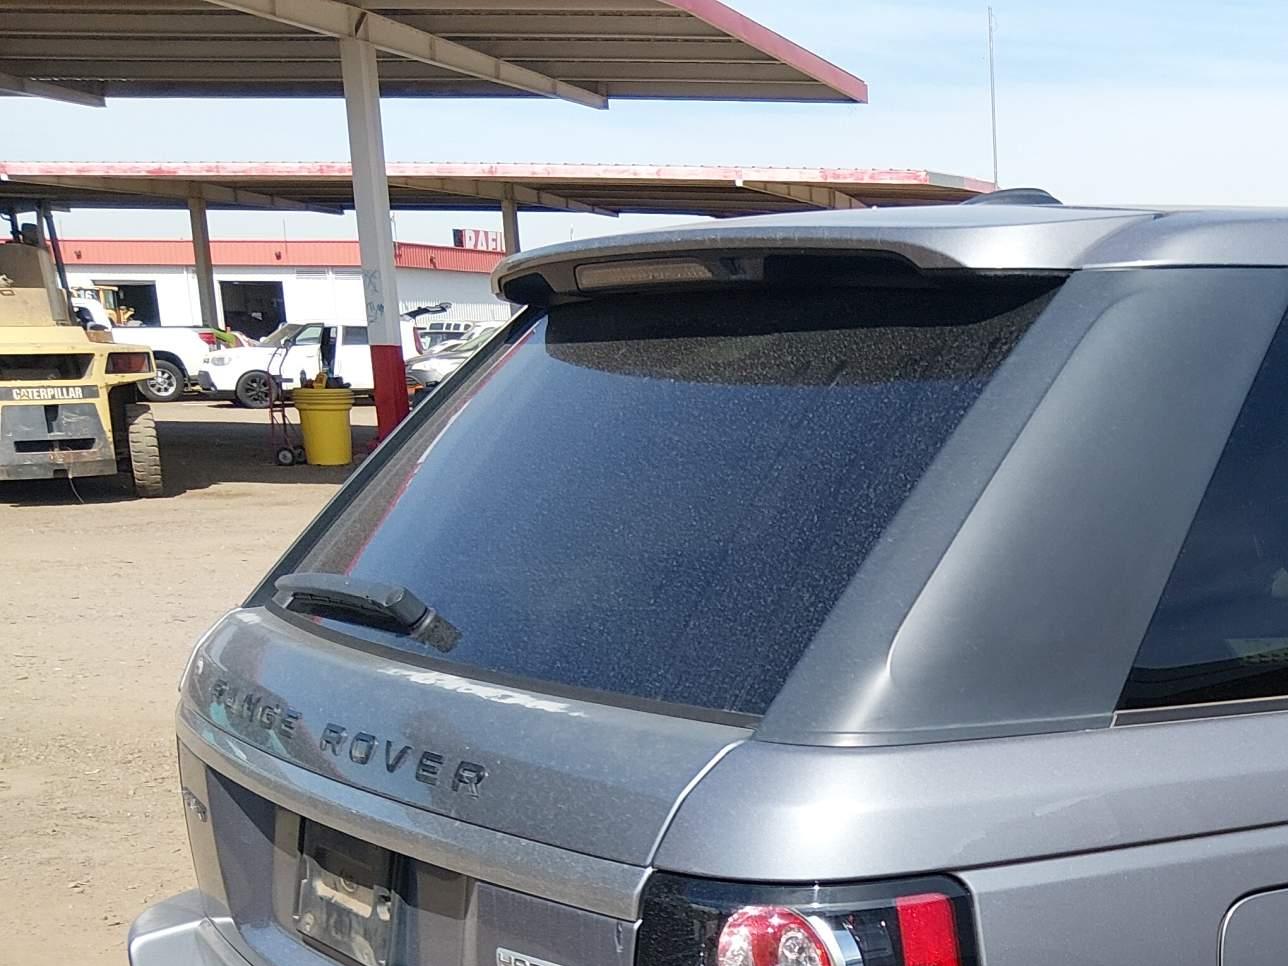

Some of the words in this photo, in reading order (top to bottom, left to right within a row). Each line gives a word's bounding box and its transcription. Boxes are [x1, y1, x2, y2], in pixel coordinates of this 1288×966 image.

[12, 386, 83, 400] CATERPILLAR
[211, 679, 303, 739] RANGE
[320, 722, 487, 800] ROVER
